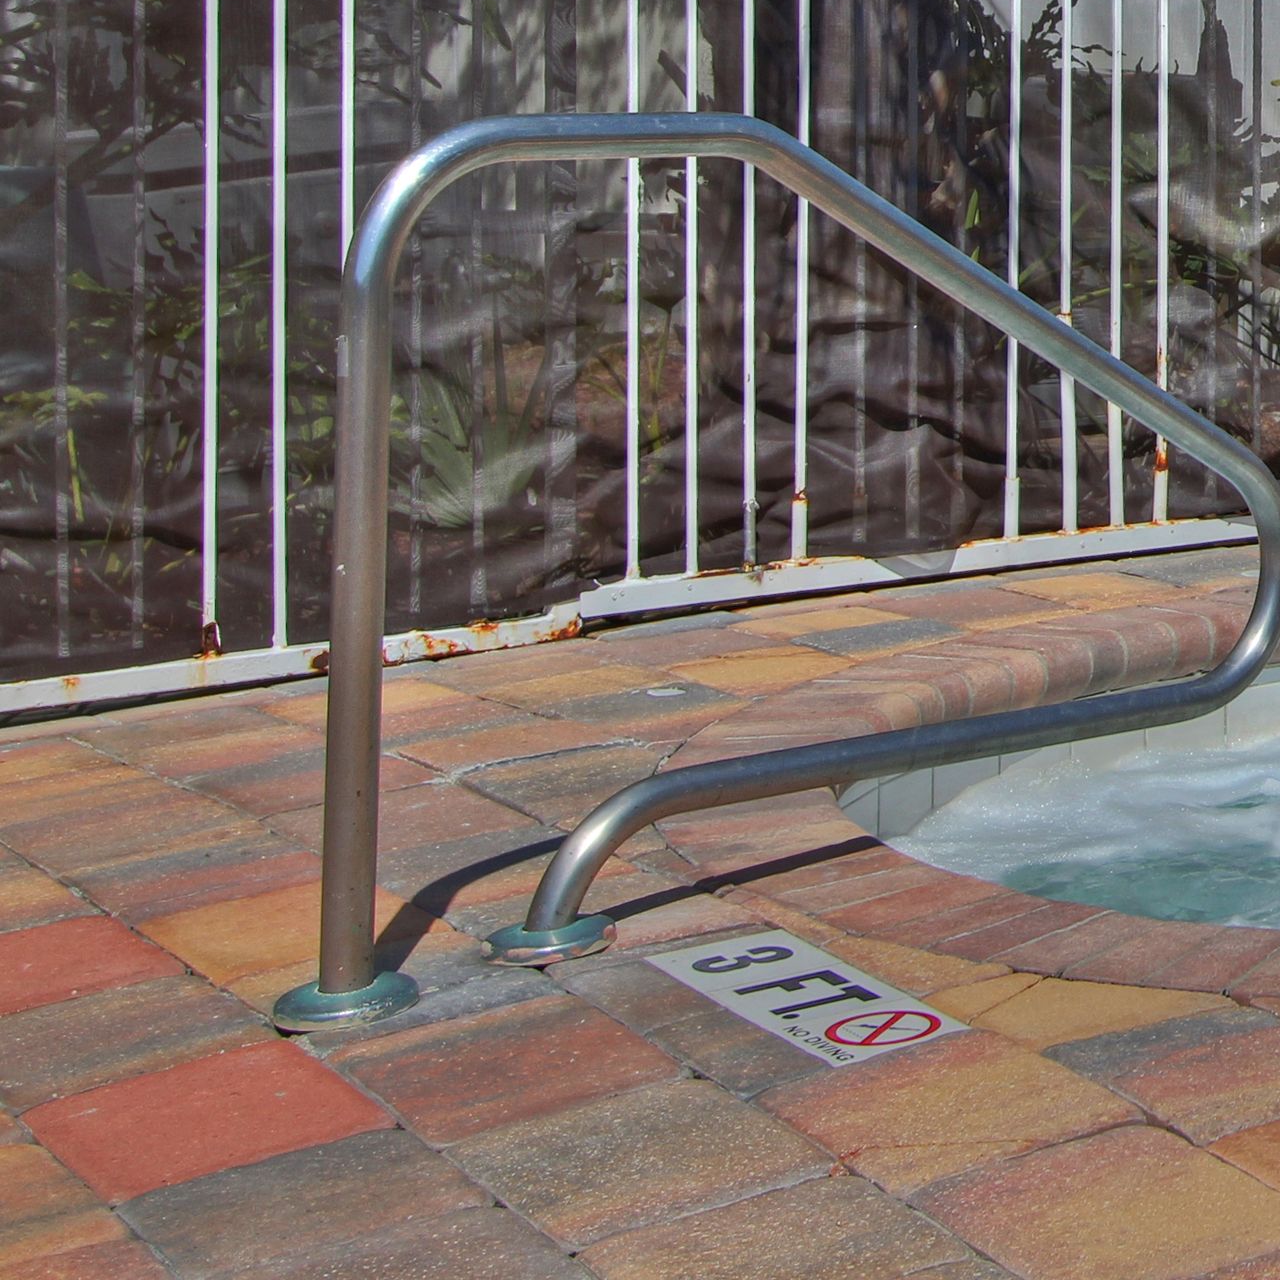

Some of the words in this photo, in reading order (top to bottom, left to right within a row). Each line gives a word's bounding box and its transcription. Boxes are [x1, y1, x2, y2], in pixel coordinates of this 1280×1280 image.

[691, 946, 793, 973] 3
[734, 970, 881, 1019] FT.
[783, 1024, 809, 1038] NO
[804, 1035, 855, 1062] DIVING
